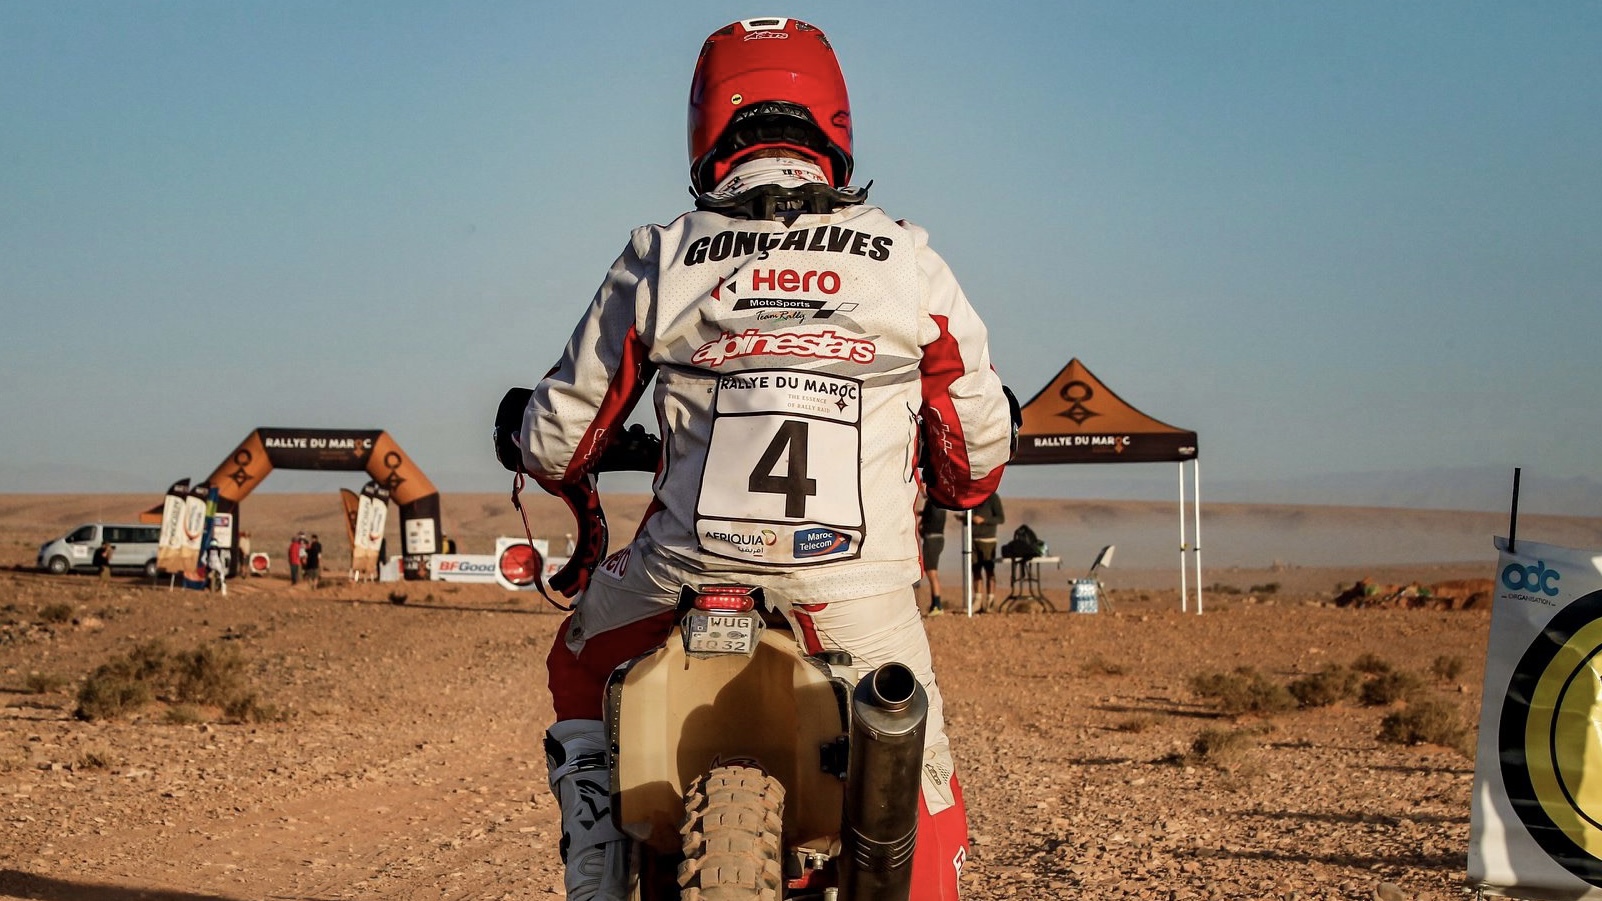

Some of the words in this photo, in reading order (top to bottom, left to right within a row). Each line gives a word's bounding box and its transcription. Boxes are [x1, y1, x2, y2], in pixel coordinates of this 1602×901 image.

[684, 226, 893, 266] GONÇALVES
[752, 269, 841, 294] Hero
[749, 299, 811, 308] MotoSports
[756, 310, 779, 320] Team
[779, 310, 805, 324] Rally
[691, 329, 876, 368] alpinestars
[720, 376, 769, 390] RALLYE
[775, 376, 798, 389] DU
[804, 379, 857, 399] MAROC
[802, 396, 827, 404] ESSENCE
[265, 438, 307, 449] RALLYE
[310, 438, 326, 448] DU
[329, 439, 372, 449] MAROC
[1034, 436, 1072, 447] RALLYE
[1074, 436, 1089, 446] DU
[1091, 436, 1130, 446] MAROC
[748, 420, 816, 518] 4
[706, 531, 764, 546] AFRIQUIA
[807, 532, 833, 541] Maroc
[800, 540, 832, 550] Telecom
[439, 561, 496, 572] BFGood
[710, 617, 749, 628] WUG
[722, 640, 746, 651] 32
